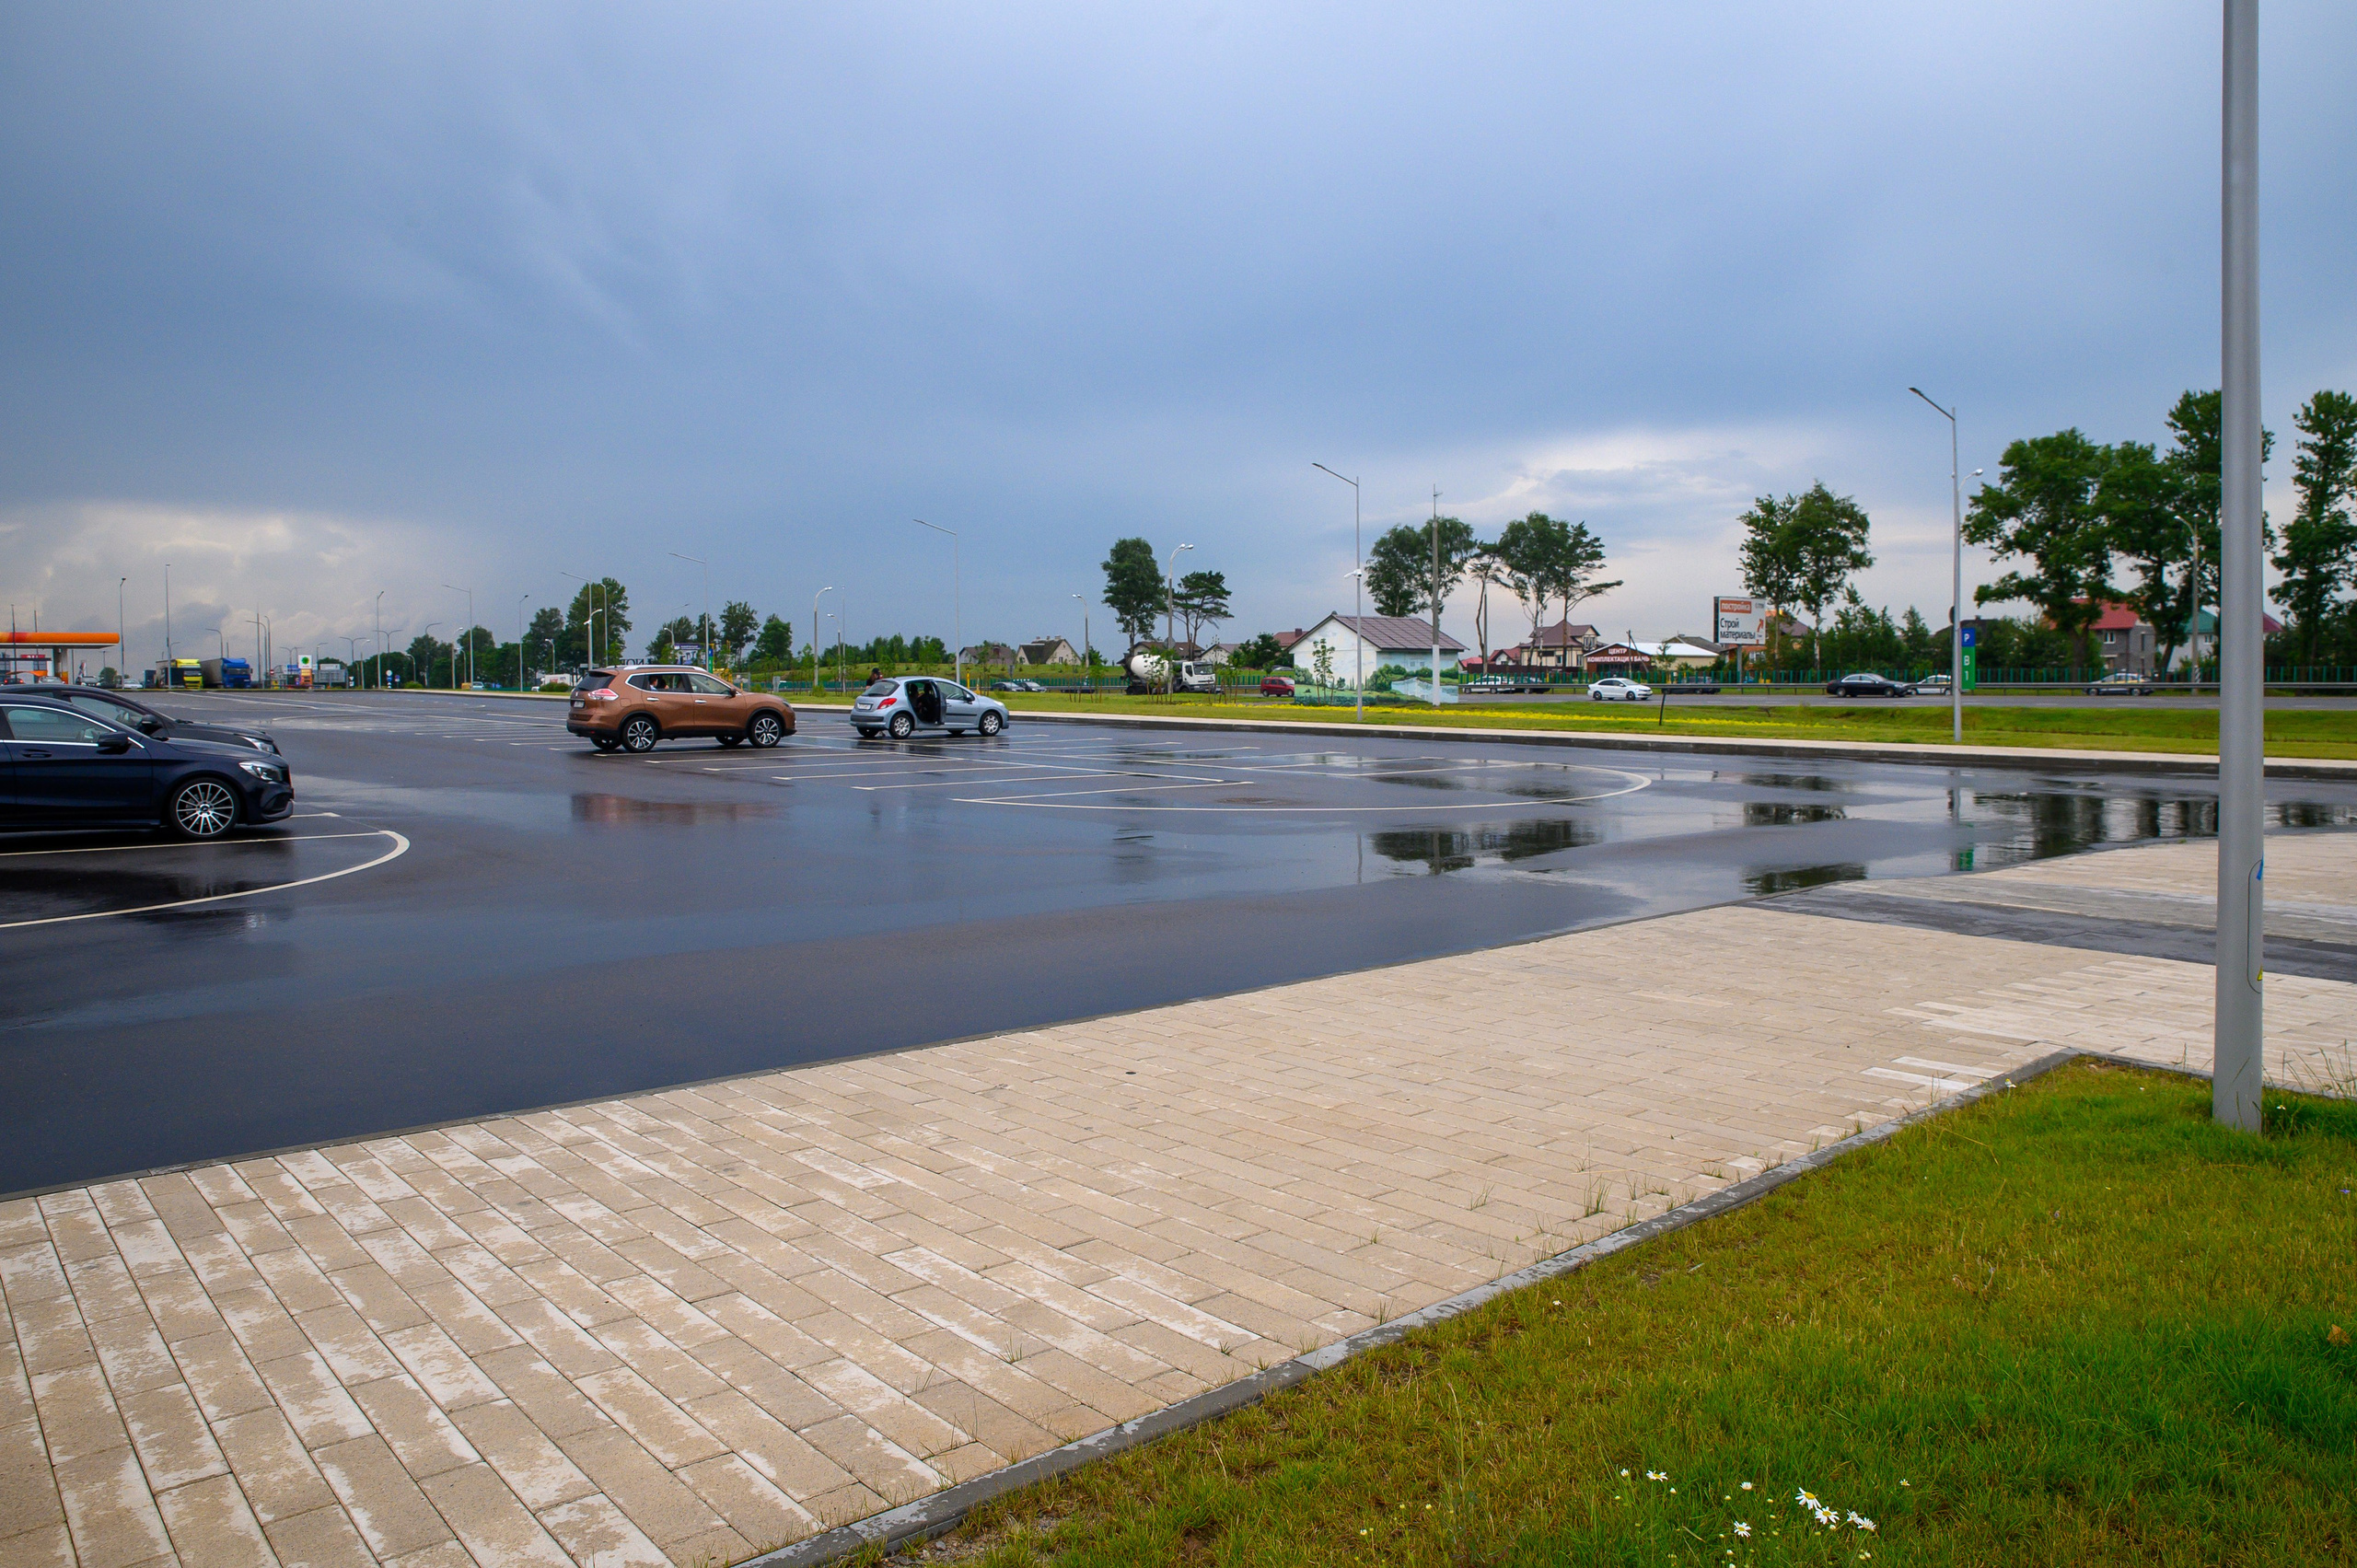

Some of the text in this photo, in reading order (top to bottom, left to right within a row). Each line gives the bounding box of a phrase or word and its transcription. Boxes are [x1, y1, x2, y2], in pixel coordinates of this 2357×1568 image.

[1721, 601, 1750, 612] постройка
[1720, 618, 1739, 631] Строй
[1720, 631, 1756, 641] материалы
[1964, 633, 1970, 643] P
[1964, 656, 1970, 666] B
[1965, 671, 1969, 680] 1
